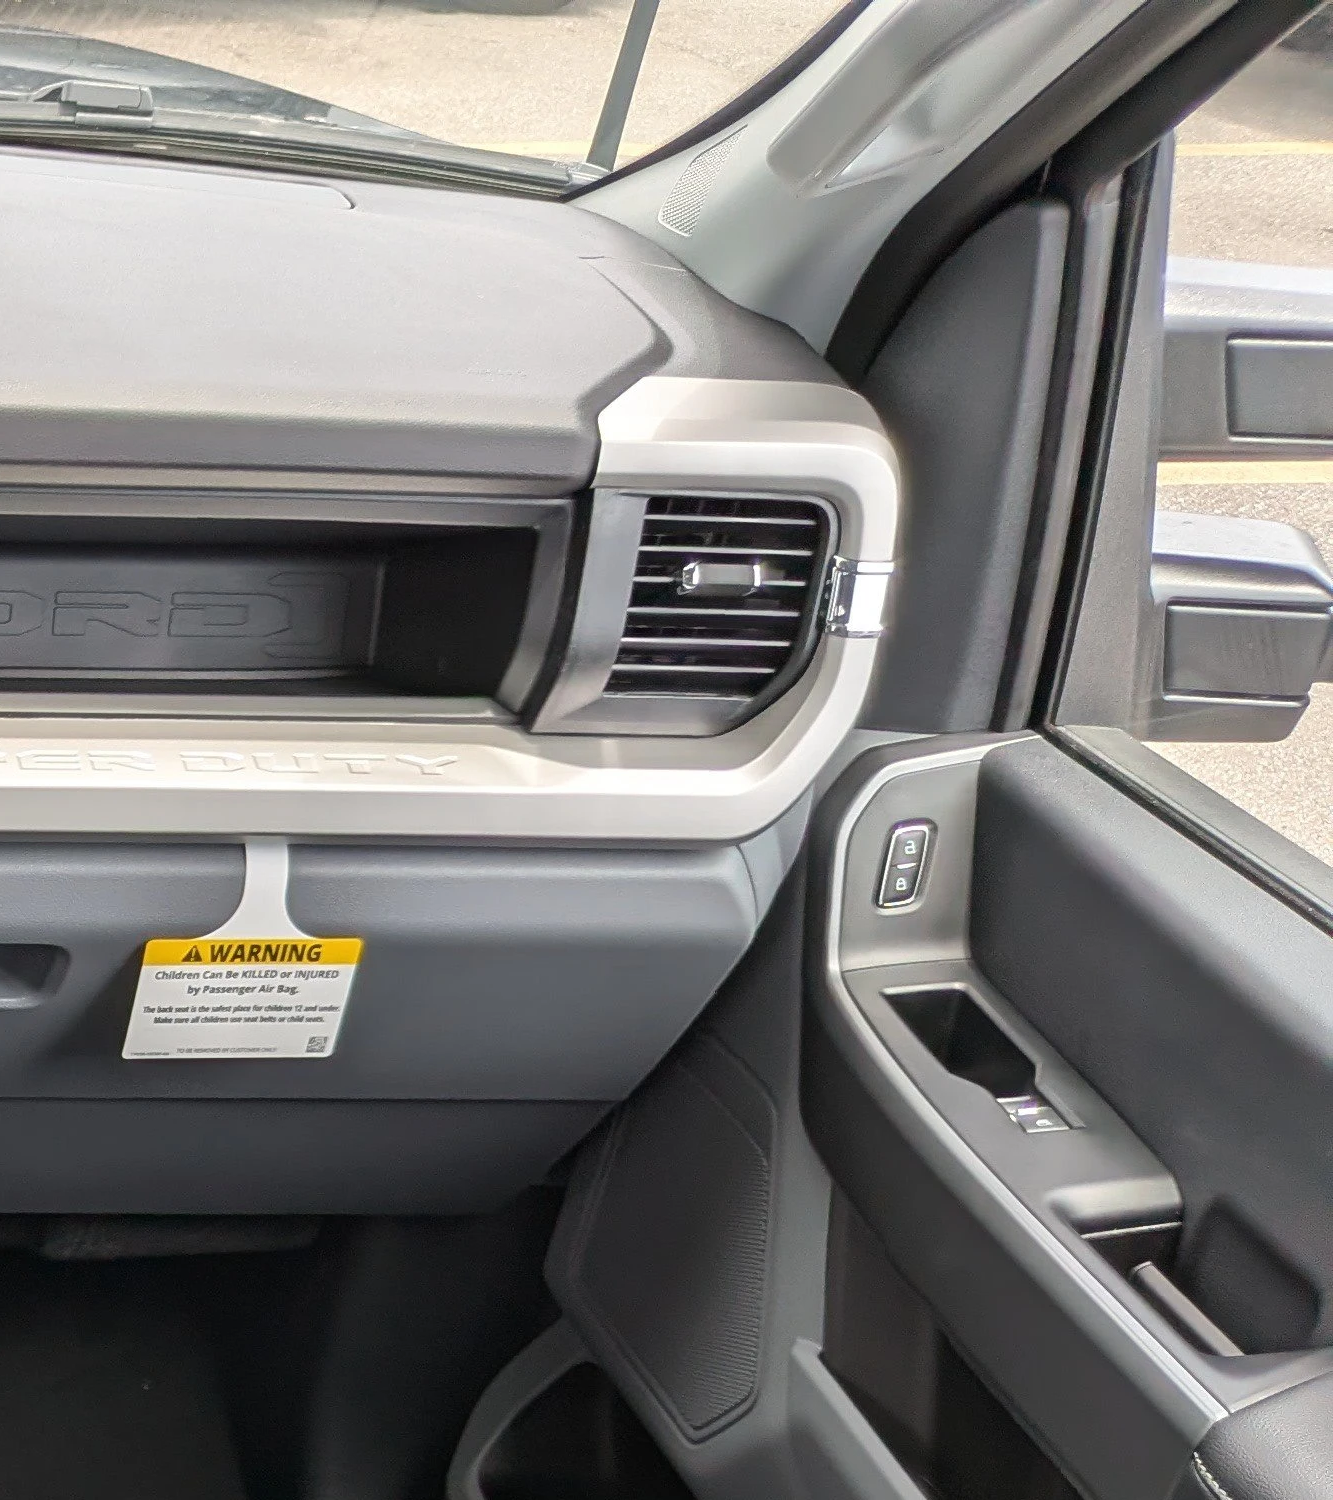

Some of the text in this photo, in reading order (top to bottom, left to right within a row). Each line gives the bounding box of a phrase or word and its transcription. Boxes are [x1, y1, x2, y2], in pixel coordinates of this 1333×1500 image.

[179, 750, 460, 777] DUTY
[209, 943, 323, 963] WARNING
[155, 969, 339, 981] Children Can Be KILLED or INJURED
[187, 984, 299, 996] by Passenger Air Bag.
[143, 1005, 156, 1013] The
[198, 1005, 210, 1013] the
[232, 1004, 251, 1013] place
[264, 1004, 293, 1012] children
[303, 1004, 317, 1012] and
